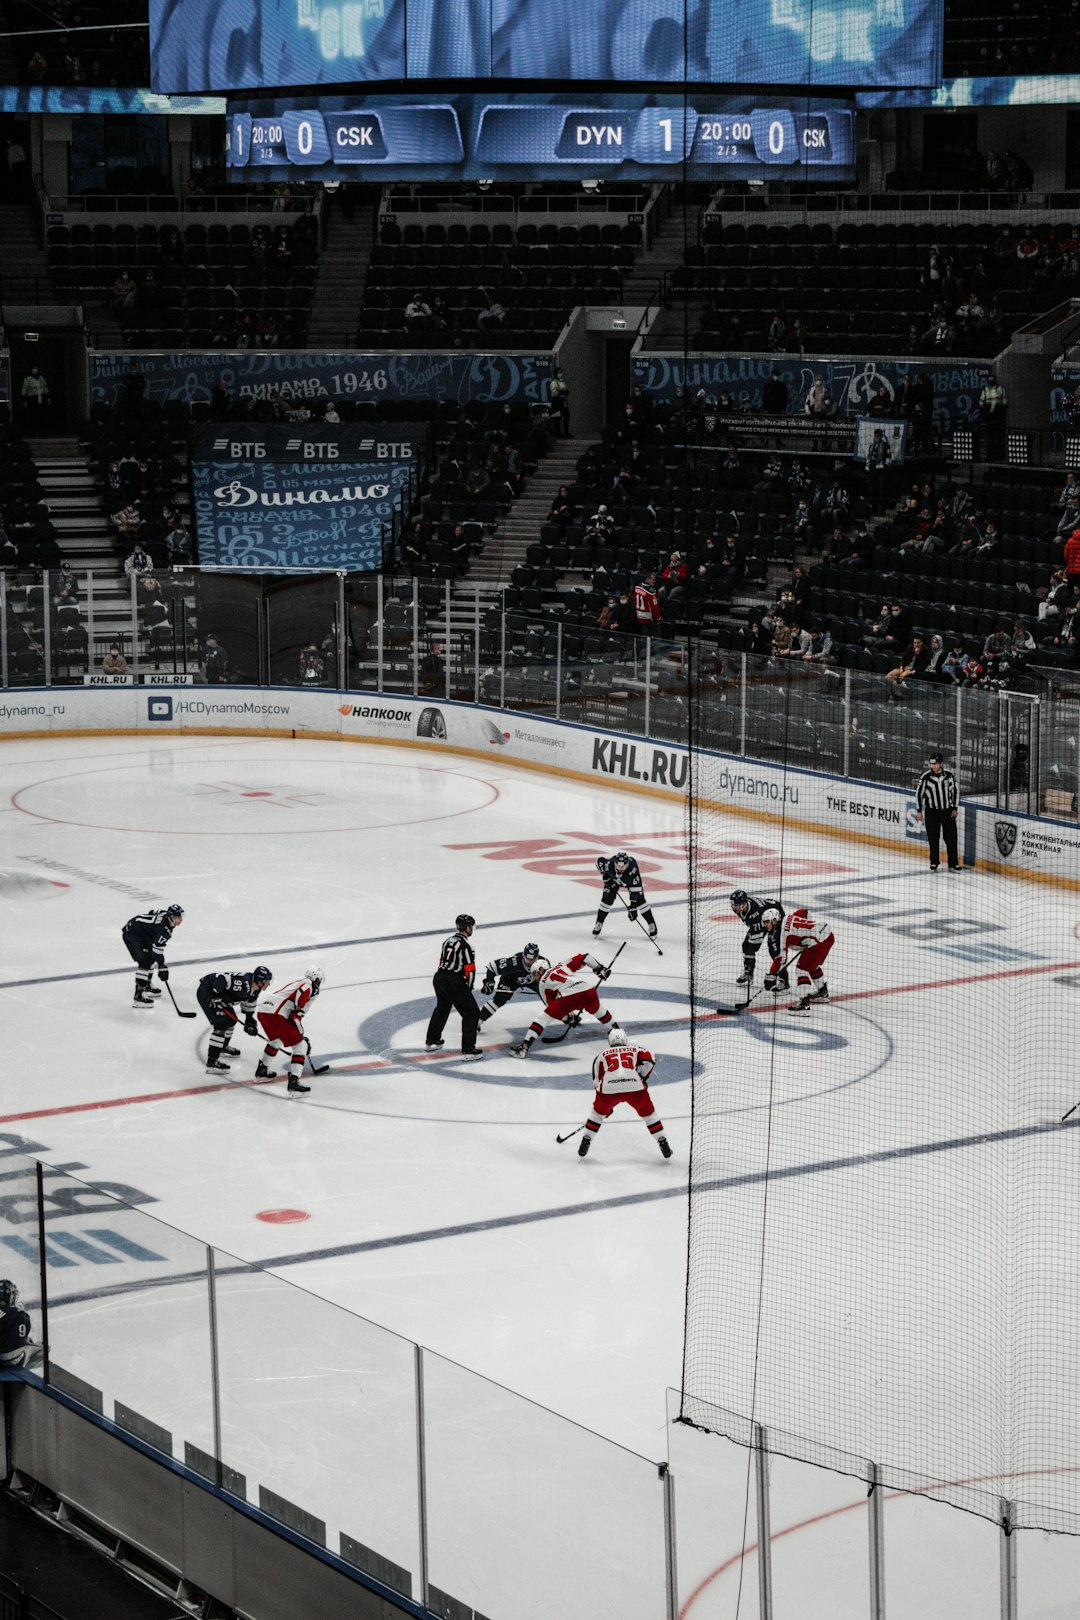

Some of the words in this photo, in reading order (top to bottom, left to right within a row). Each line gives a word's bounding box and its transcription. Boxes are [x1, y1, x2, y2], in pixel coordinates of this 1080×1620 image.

[236, 124, 243, 155] 1
[252, 126, 282, 144] 20:00
[297, 121, 313, 154] 0
[336, 127, 373, 146] CSK
[576, 126, 622, 146] DYN
[658, 118, 672, 152] 1
[701, 122, 751, 141] 20:00
[768, 121, 784, 154] 0
[803, 129, 826, 148] CSK
[260, 148, 273, 159] 2/3
[717, 145, 738, 156] 2/3
[239, 378, 321, 397] ДИНАМО
[331, 369, 388, 396] 1946
[230, 442, 267, 458] ВТБ
[303, 442, 340, 458] ВТБ
[376, 442, 413, 459] ВТБ
[303, 472, 389, 487] MOSCOW
[213, 480, 391, 508] Динамо
[327, 502, 392, 520] 1946
[89, 675, 128, 685] KHL.RU
[150, 675, 188, 685] KHL.RU
[175, 701, 290, 716] /HCDynamoMoscow
[514, 728, 567, 749] Металлоинвест
[592, 737, 689, 788] KHL.RU
[720, 766, 799, 805] dynamo.ru
[826, 796, 846, 813] THE
[849, 801, 876, 819] BEST
[878, 807, 900, 825] RUN
[1021, 839, 1062, 855] ХОККЕЙНАЯ
[1021, 848, 1038, 859] ЛИГА
[604, 1053, 635, 1073] 55
[18, 1323, 27, 1338] 9
